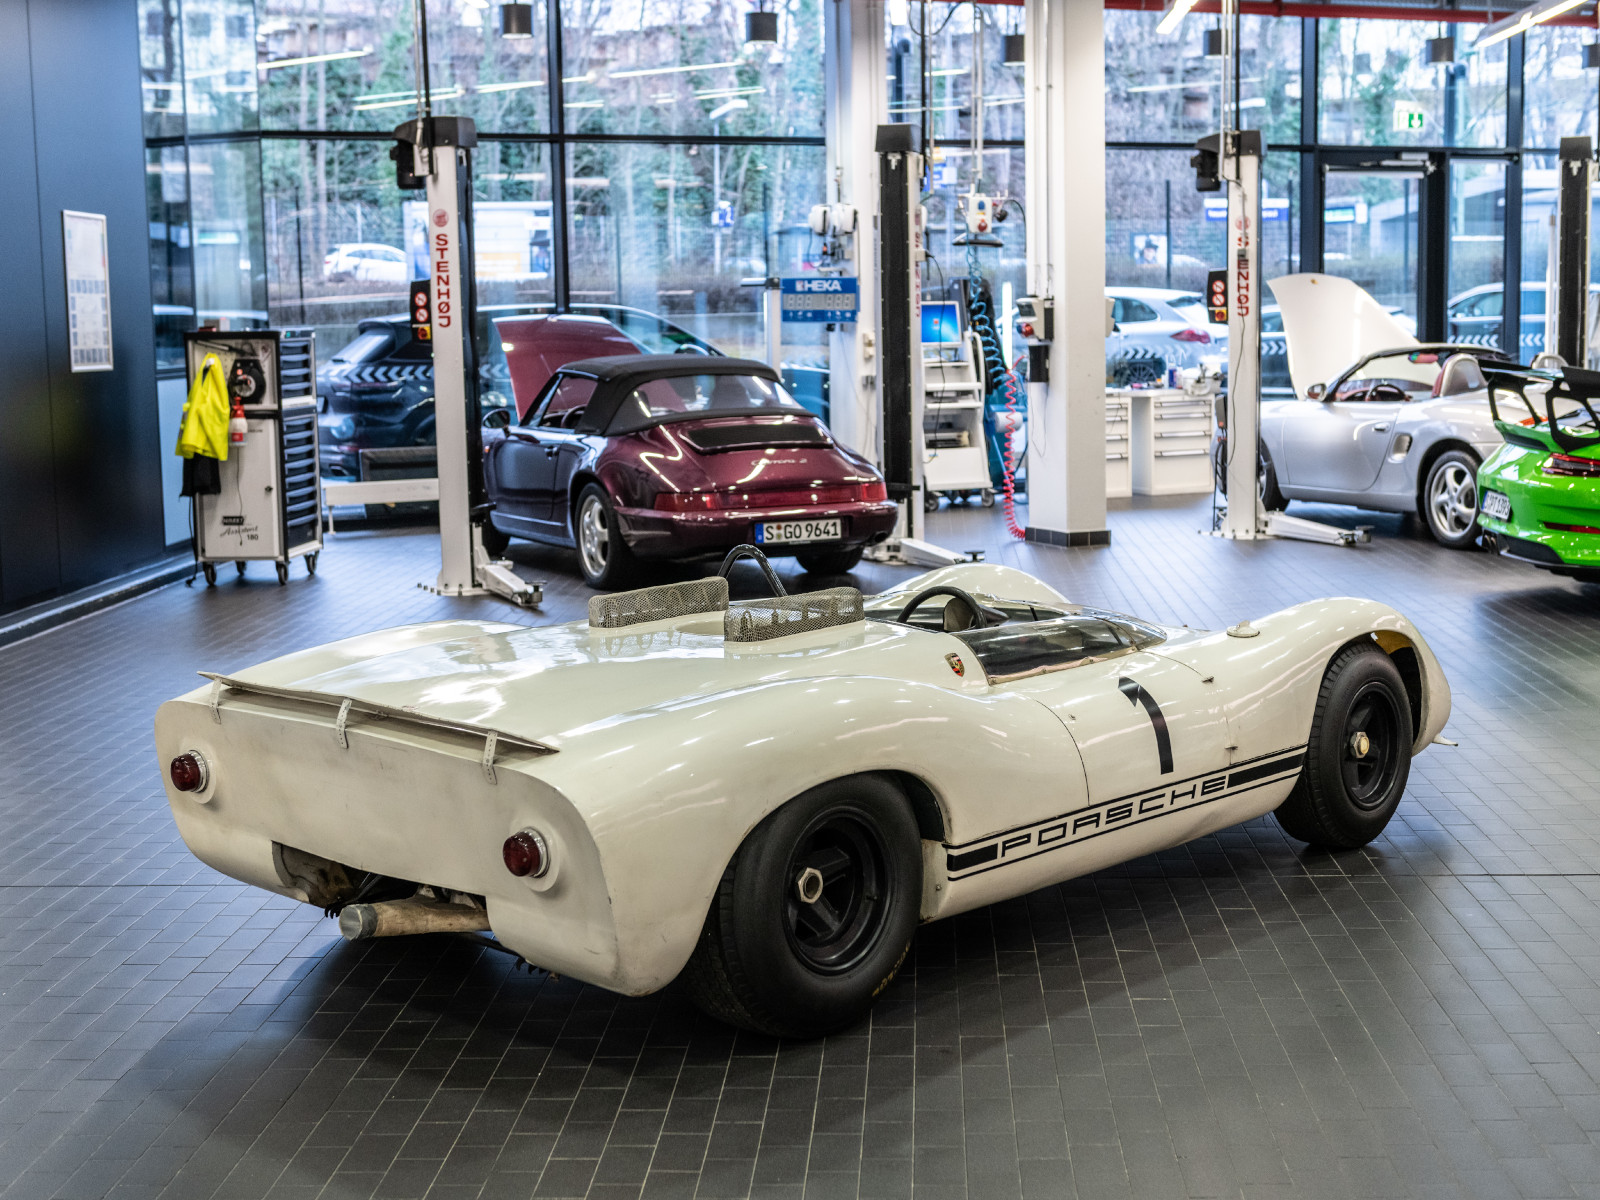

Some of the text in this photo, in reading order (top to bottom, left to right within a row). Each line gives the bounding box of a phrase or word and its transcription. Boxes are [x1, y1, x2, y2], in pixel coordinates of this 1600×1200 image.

[435, 233, 451, 328] STENHØJ
[804, 279, 843, 292] HEKA
[1237, 235, 1249, 317] SENHØJ
[765, 521, 839, 540] S GO 9641
[1118, 676, 1174, 775] 1
[1001, 775, 1227, 858] PORSCHE
